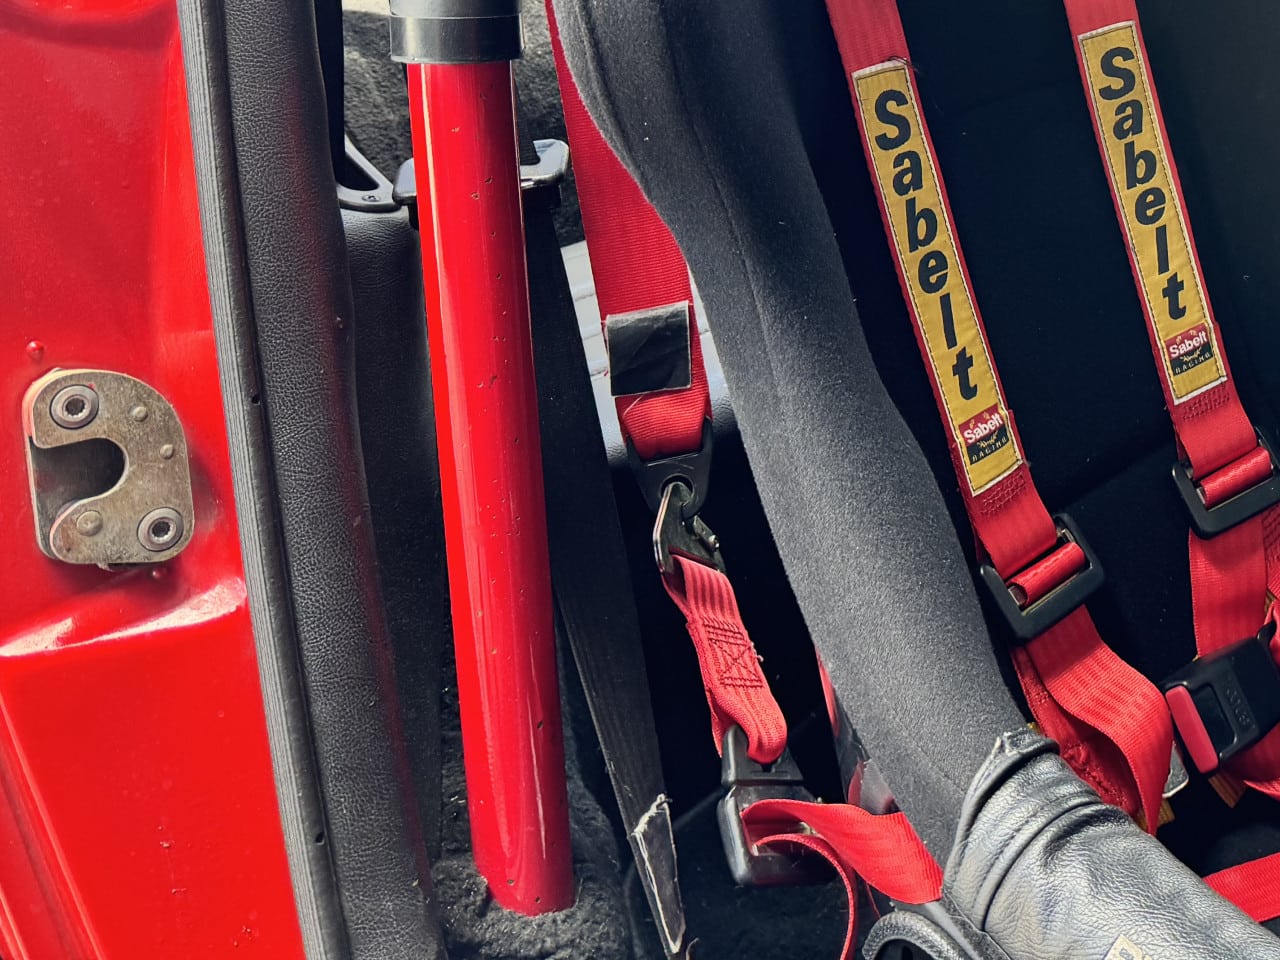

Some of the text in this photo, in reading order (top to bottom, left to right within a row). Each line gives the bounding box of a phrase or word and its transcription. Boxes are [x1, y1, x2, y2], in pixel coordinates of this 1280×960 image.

[874, 89, 979, 401] Sabelt
[1098, 46, 1187, 320] Sabelt
[1169, 330, 1207, 358] Sabelt
[964, 412, 1003, 444] Sabelt
